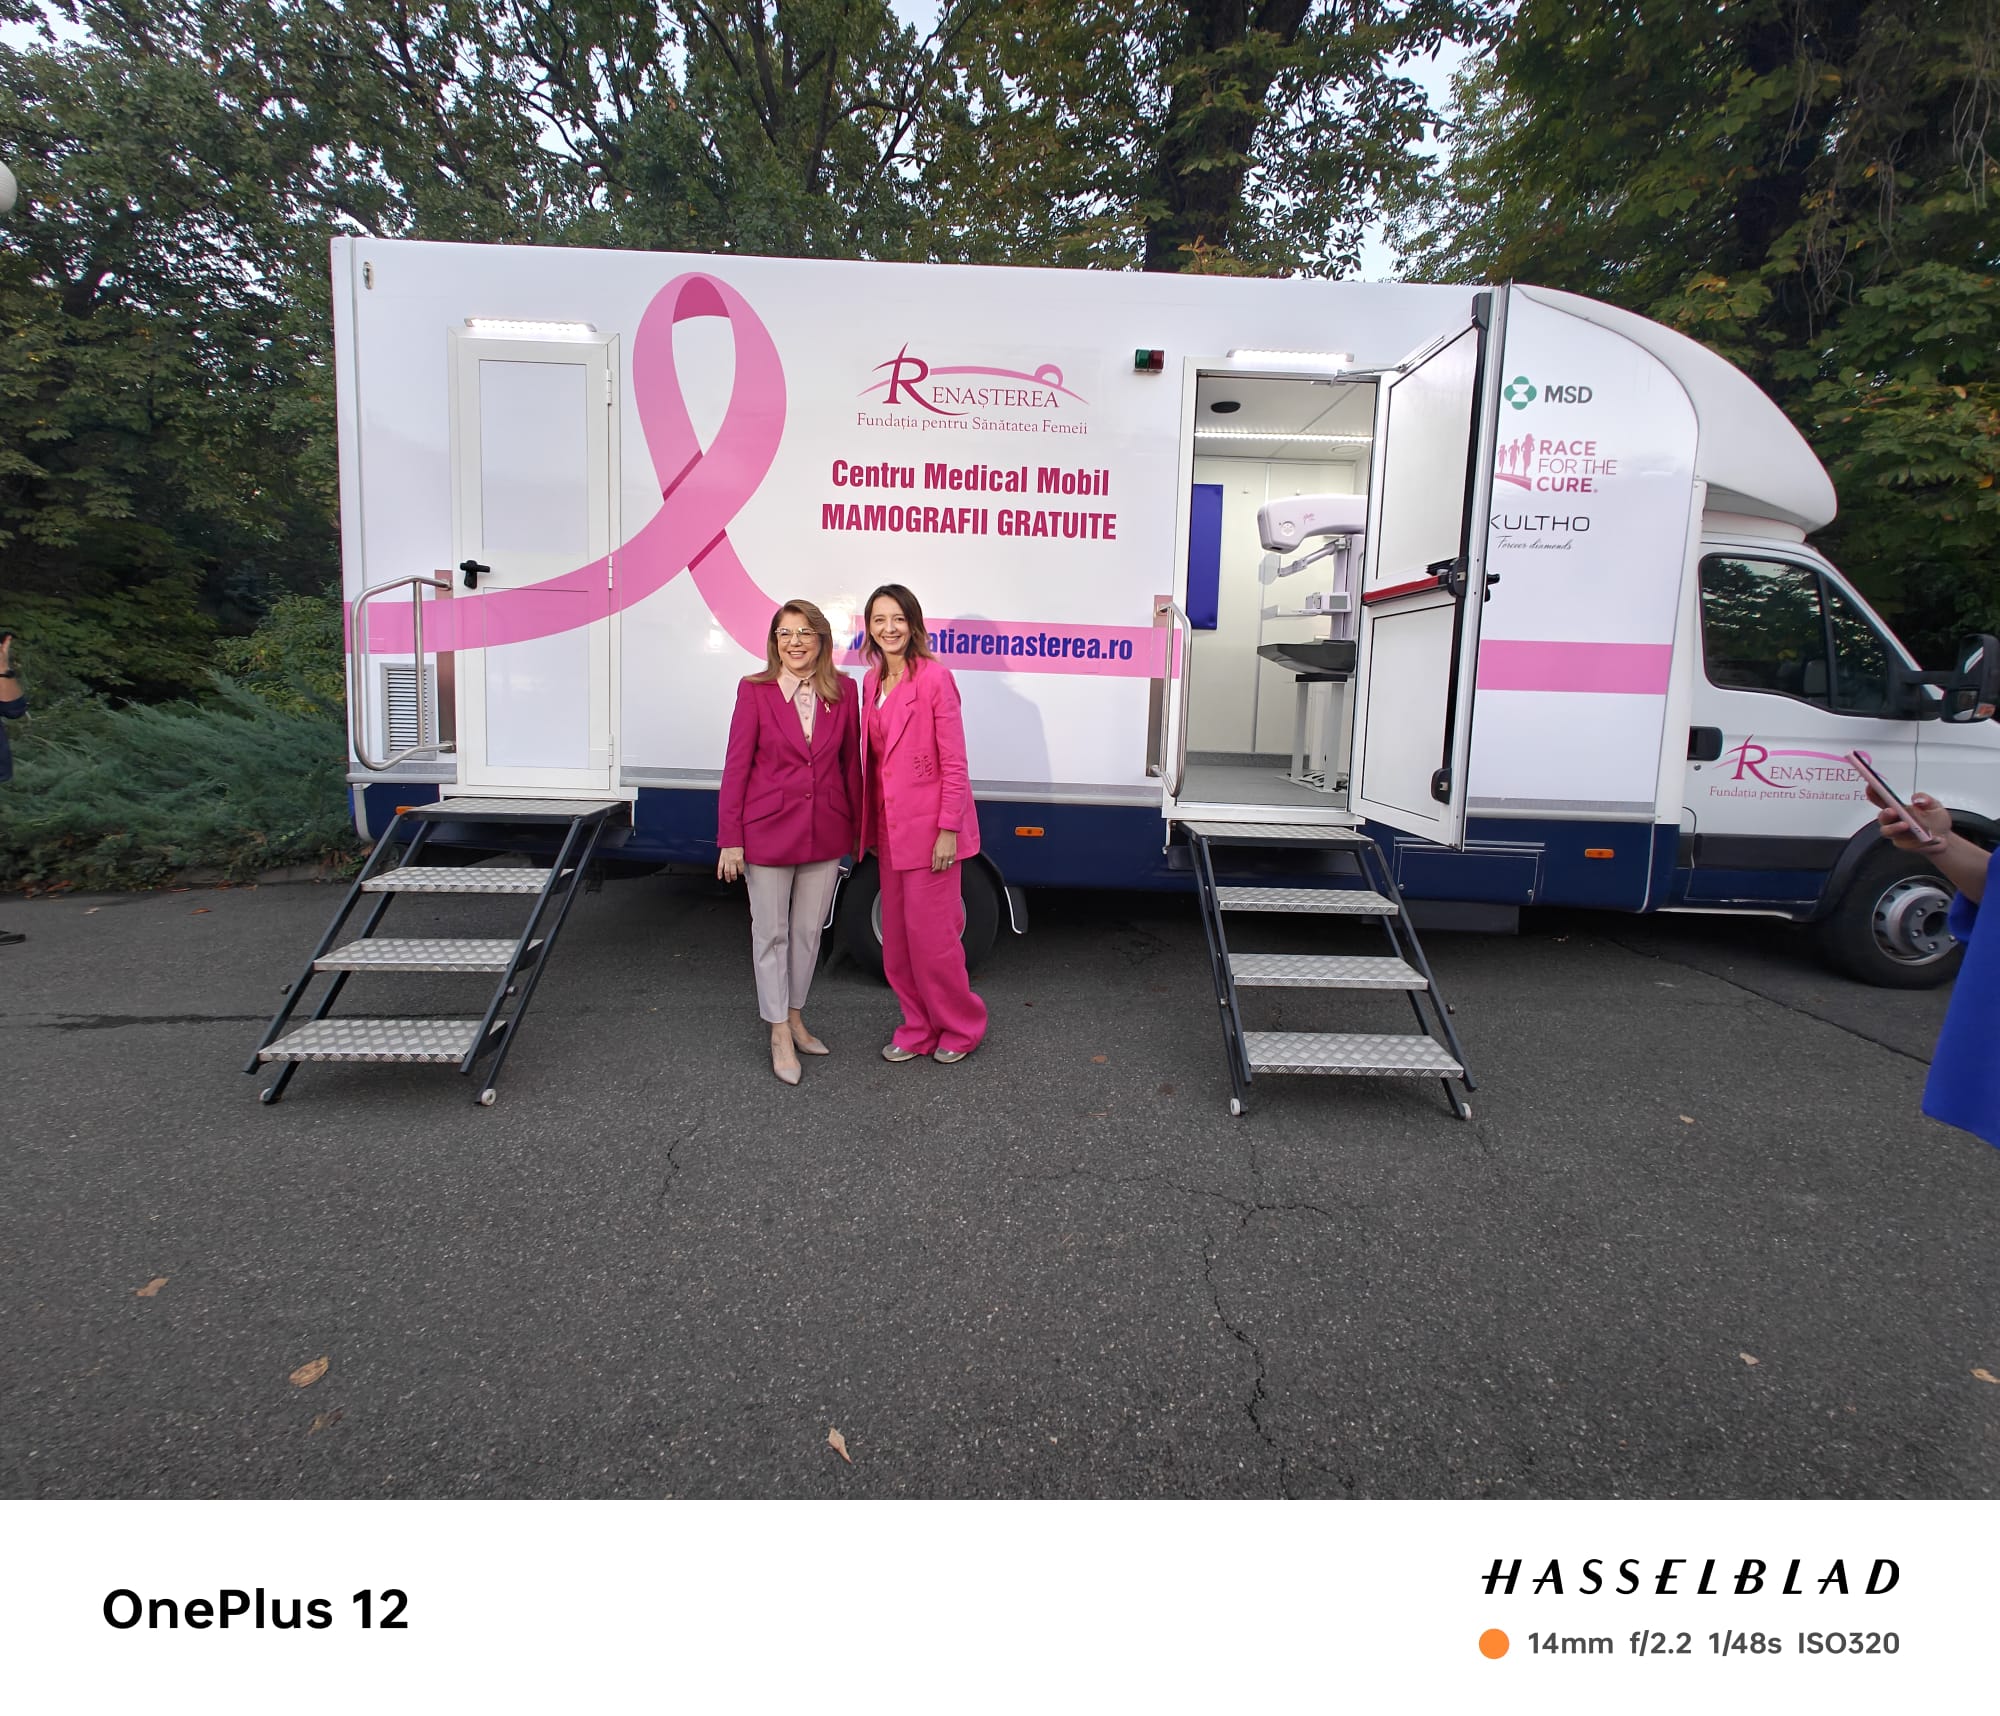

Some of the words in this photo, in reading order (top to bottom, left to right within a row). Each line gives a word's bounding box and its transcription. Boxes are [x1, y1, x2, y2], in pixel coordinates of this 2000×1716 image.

[1544, 385, 1593, 404] MSD
[857, 412, 918, 430] Fundația
[922, 418, 968, 431] pentru
[972, 416, 1038, 432] Sănătatea
[1043, 419, 1088, 435] Femeii
[1540, 440, 1597, 456] RACE
[1538, 458, 1578, 474] FOR
[1582, 459, 1618, 475] THE
[832, 459, 915, 489] Centru
[924, 463, 1028, 493] Medical
[1037, 467, 1110, 497] Mobil
[822, 503, 989, 535] MAMOGRAFII
[997, 509, 1118, 540] GRATUITE
[1496, 535, 1527, 550] Forever
[1528, 538, 1574, 551] diamonds
[1760, 789, 1796, 801] pentru
